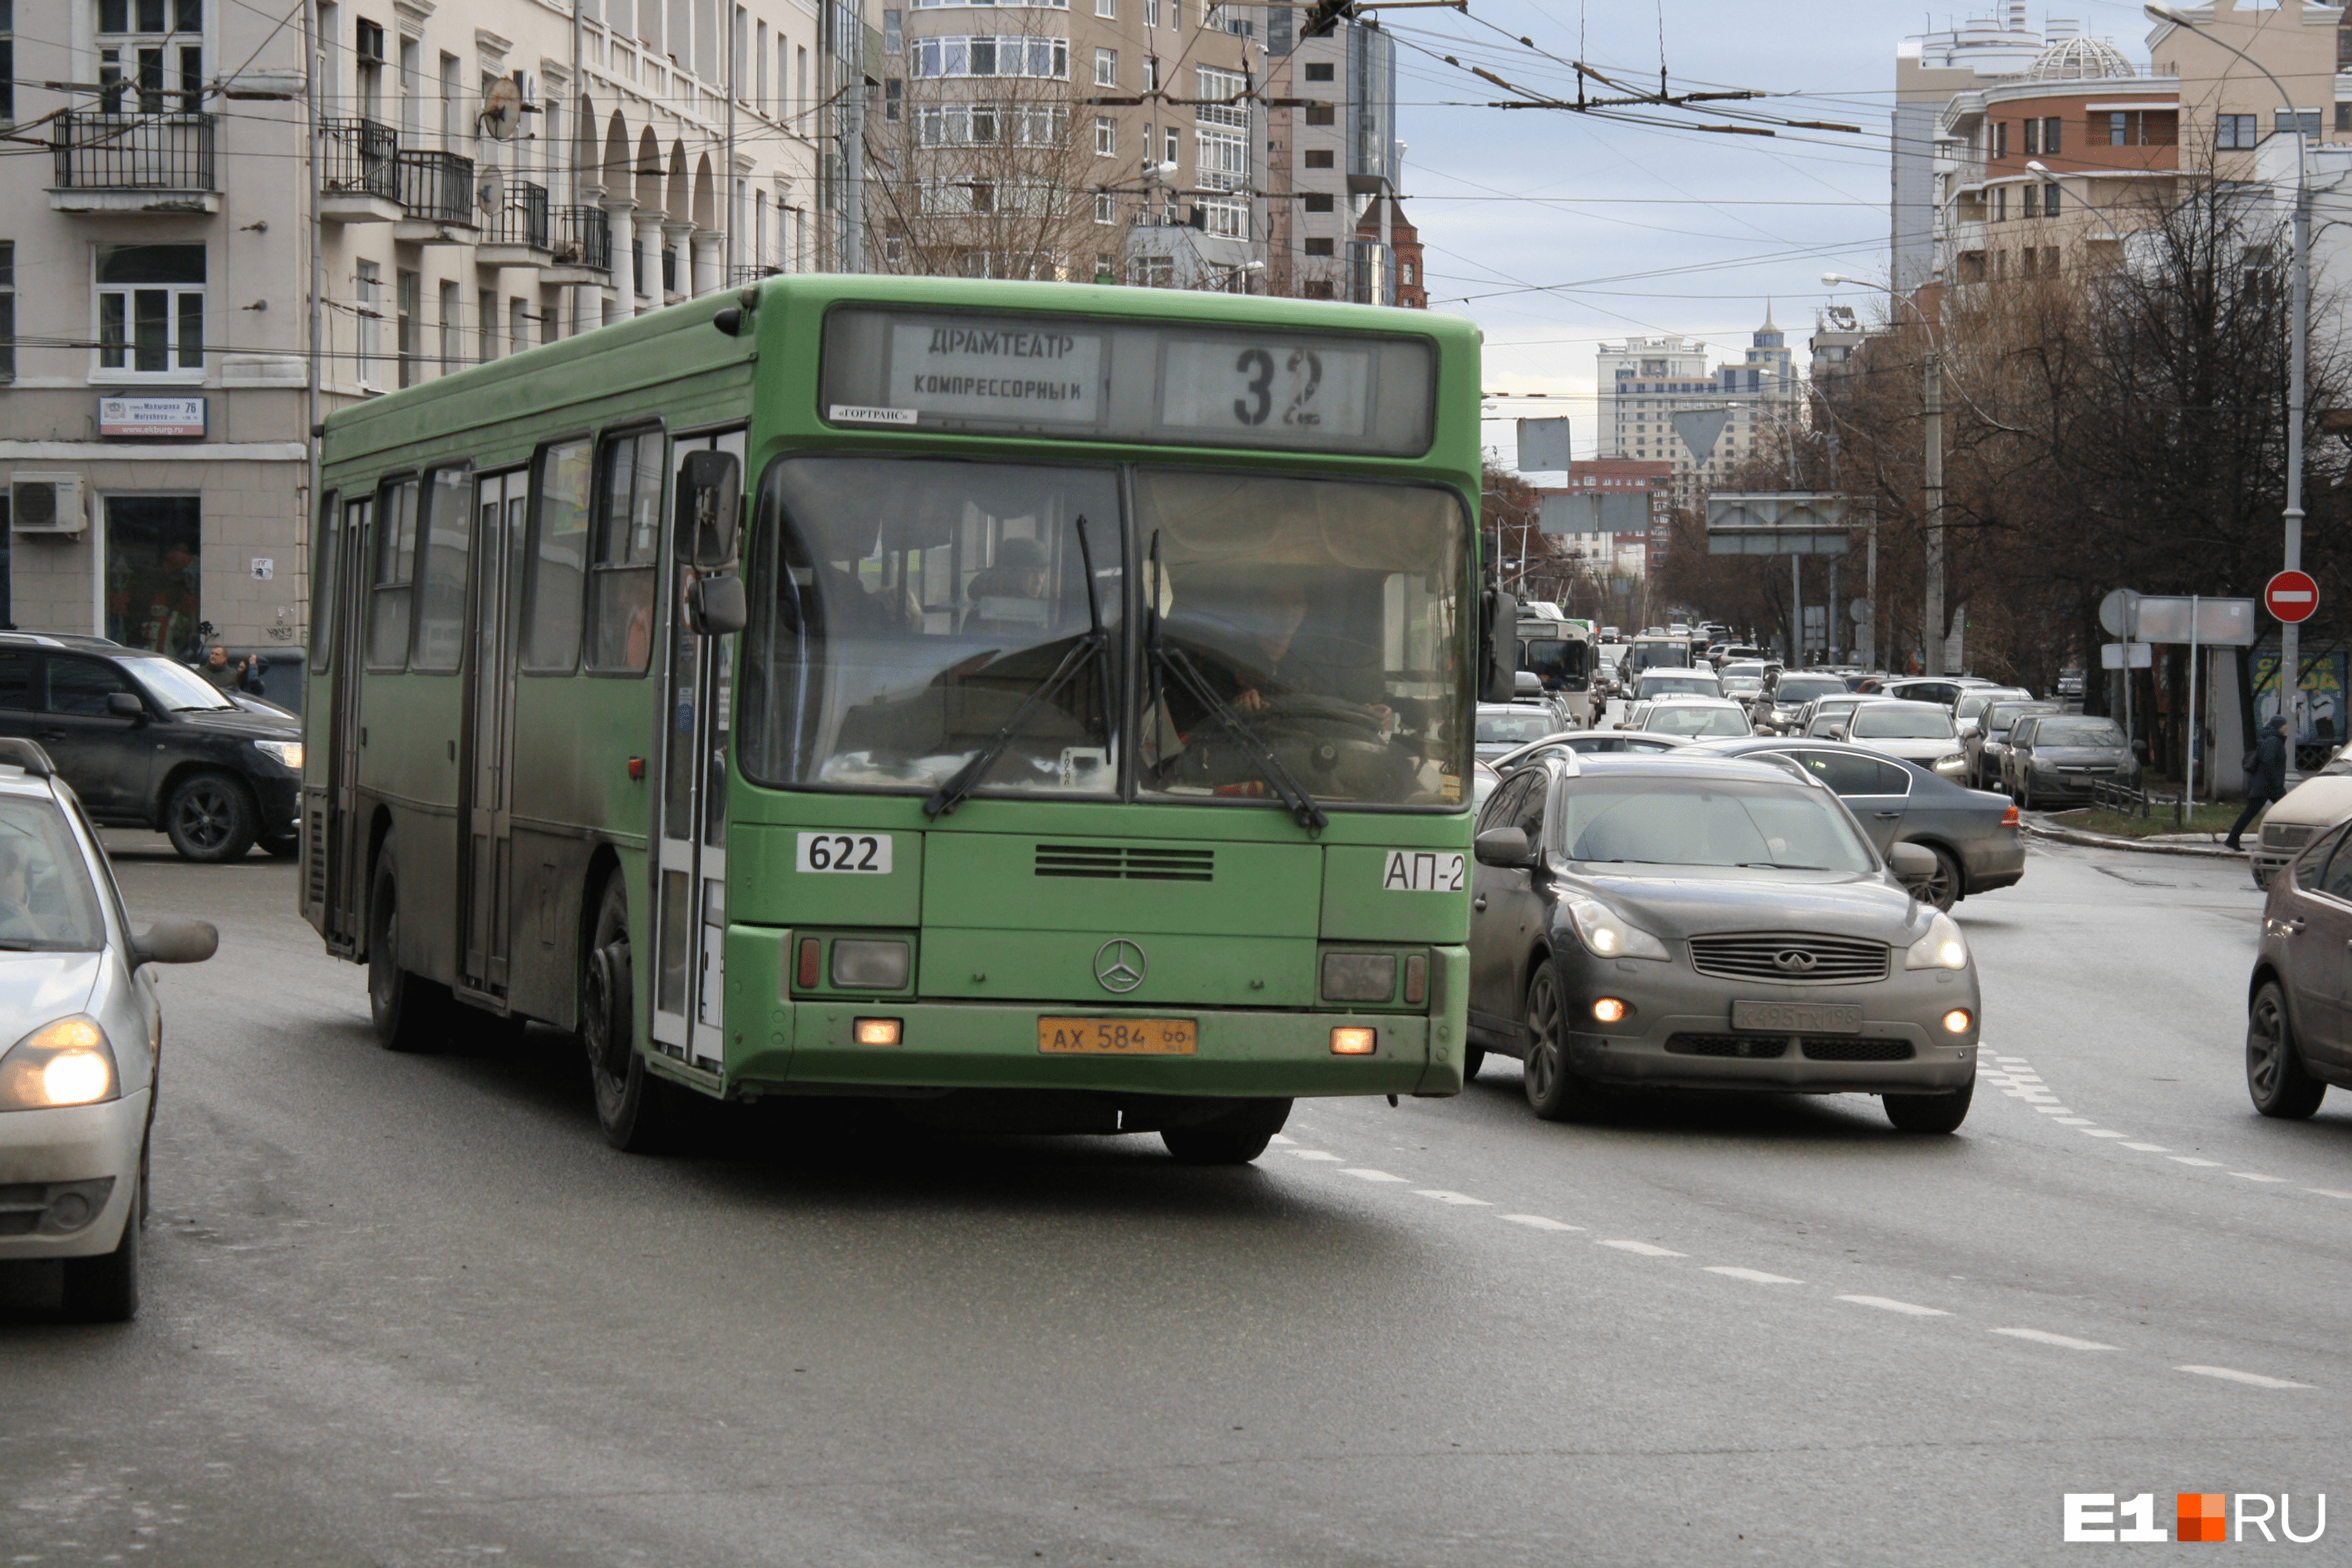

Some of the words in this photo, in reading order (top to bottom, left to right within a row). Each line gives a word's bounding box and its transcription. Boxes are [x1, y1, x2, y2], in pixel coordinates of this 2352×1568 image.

[928, 328, 1075, 359] ДРАМТЕАТР
[1233, 348, 1322, 426] 32
[185, 402, 196, 414] 76
[121, 425, 184, 435] www.ekburg.ru
[809, 835, 878, 871] 622
[1385, 852, 1464, 891] АП-2
[1098, 1023, 1145, 1049] 584
